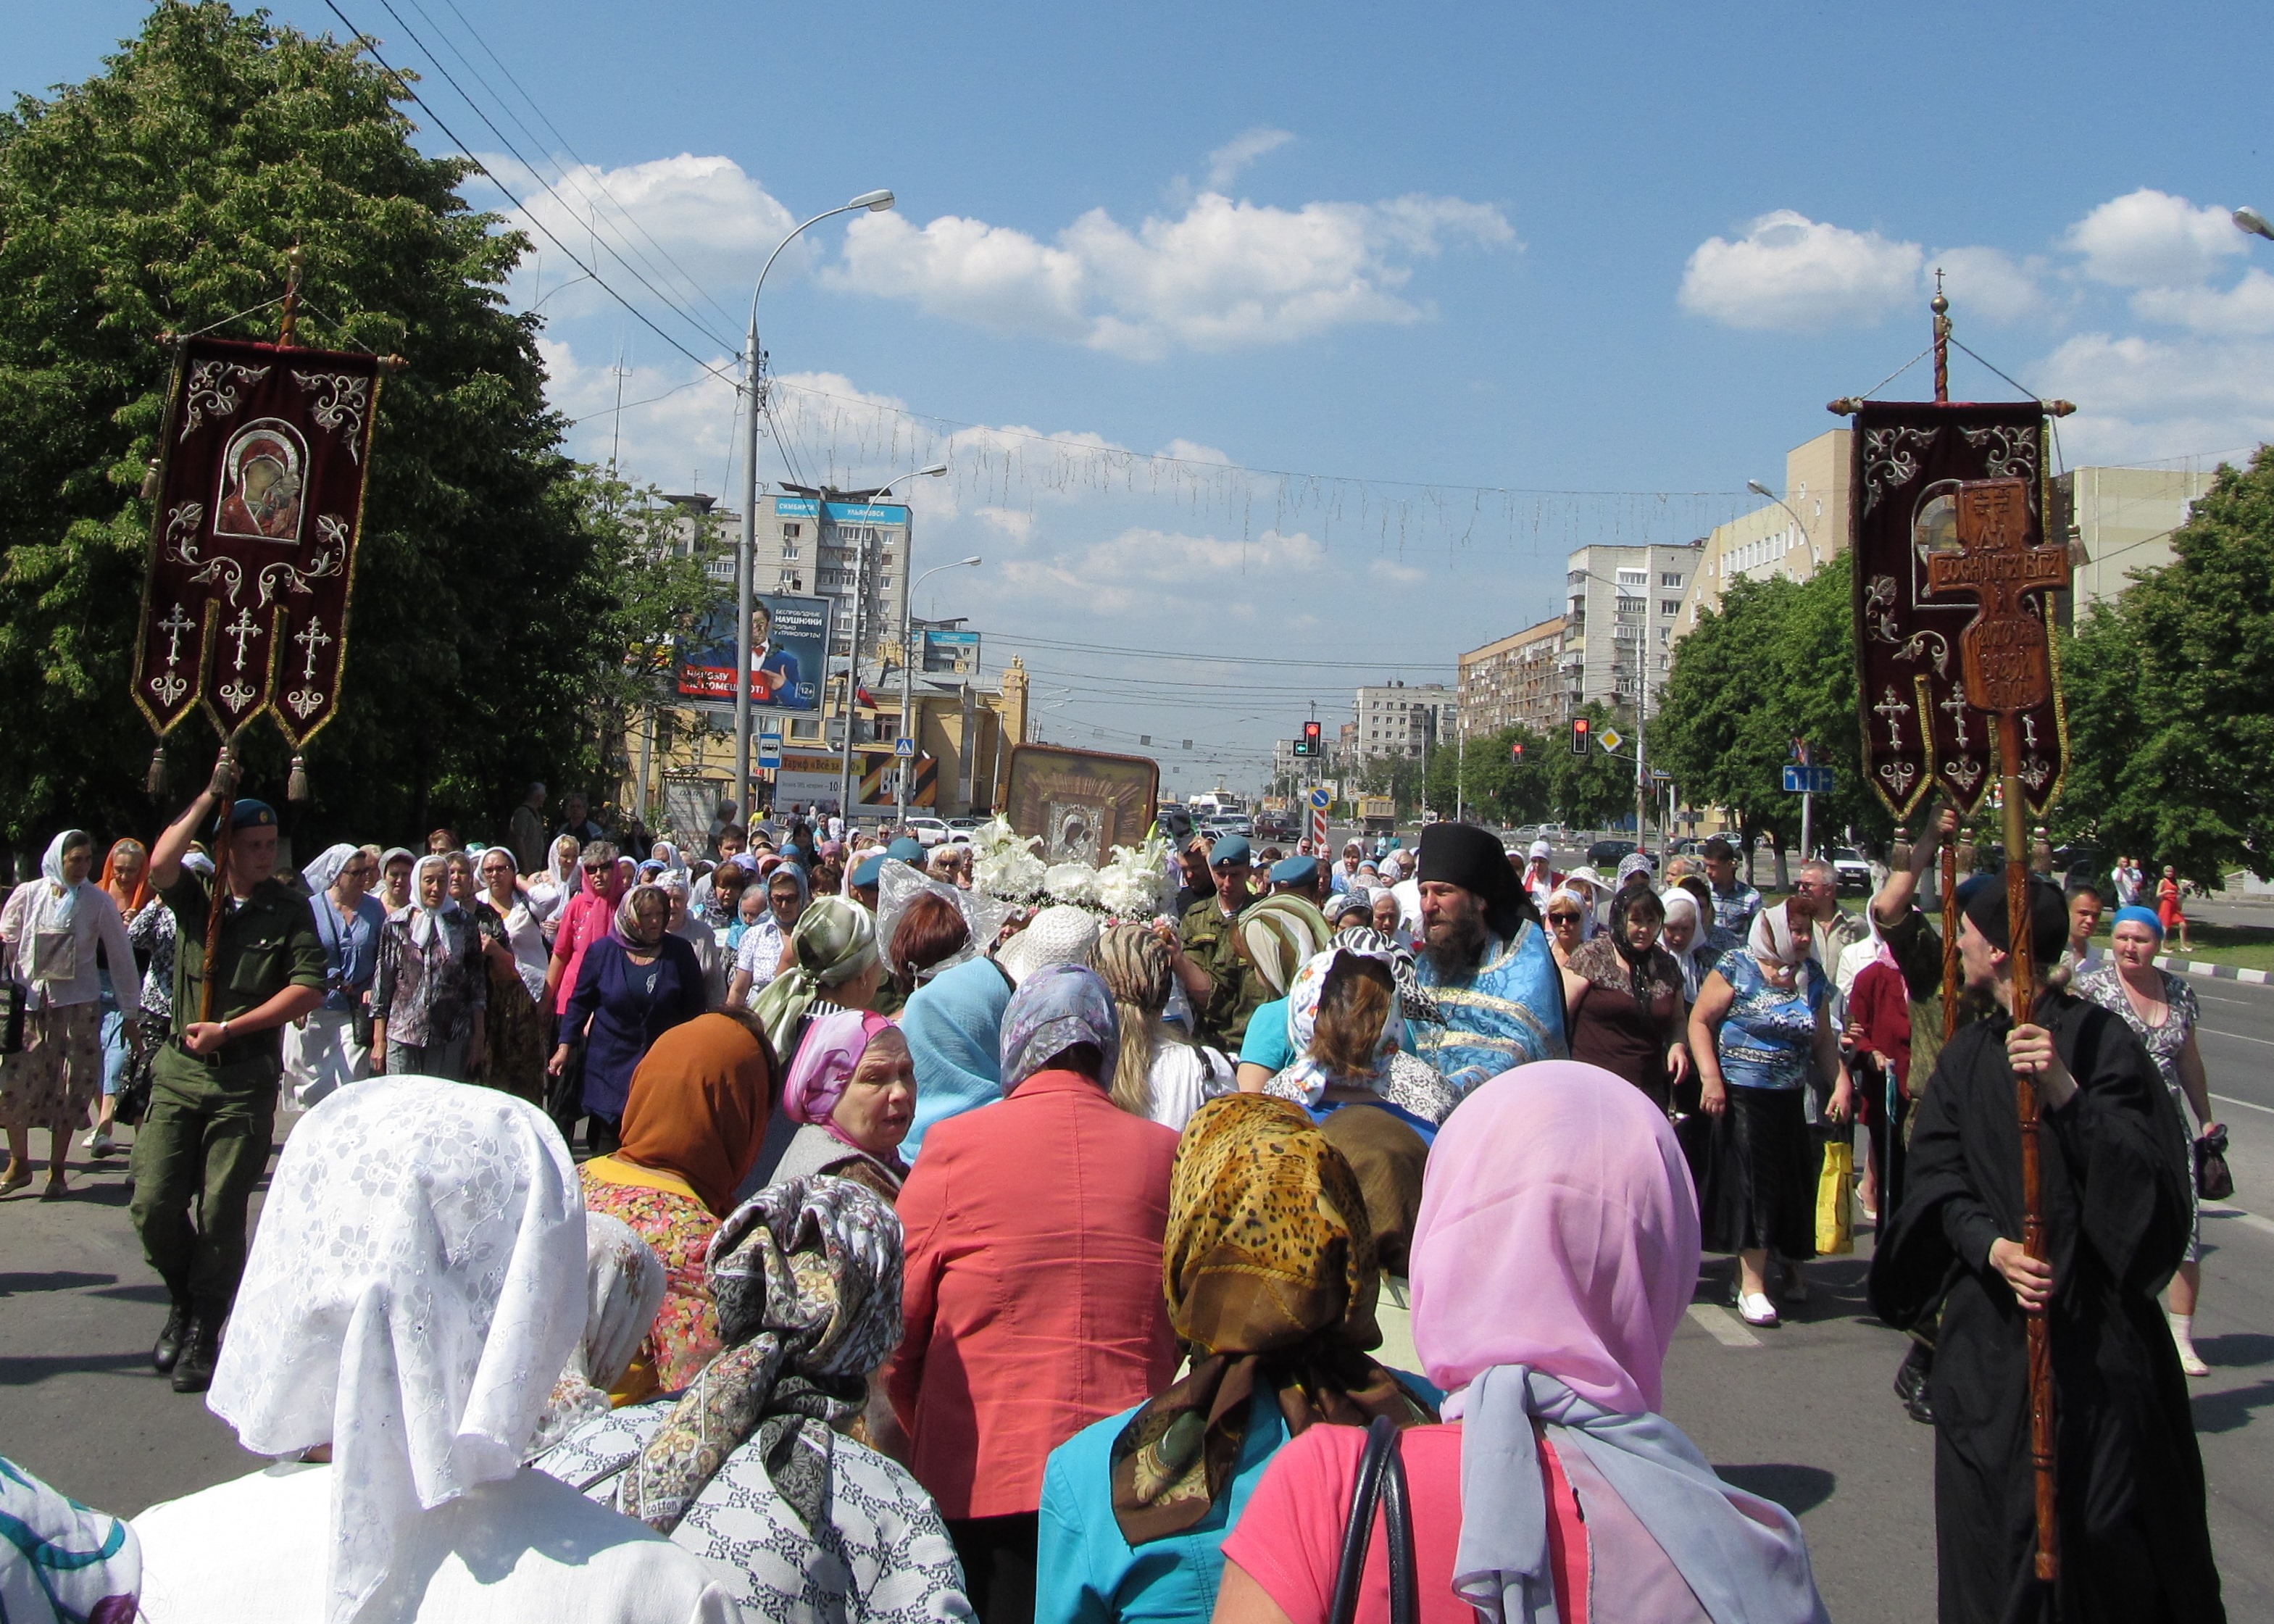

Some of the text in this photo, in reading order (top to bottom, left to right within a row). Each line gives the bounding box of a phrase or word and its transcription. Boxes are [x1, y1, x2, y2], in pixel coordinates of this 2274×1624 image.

[775, 616, 822, 626] НАУШНИКИ
[783, 757, 809, 771] Тариф
[646, 1500, 678, 1513] cotton
